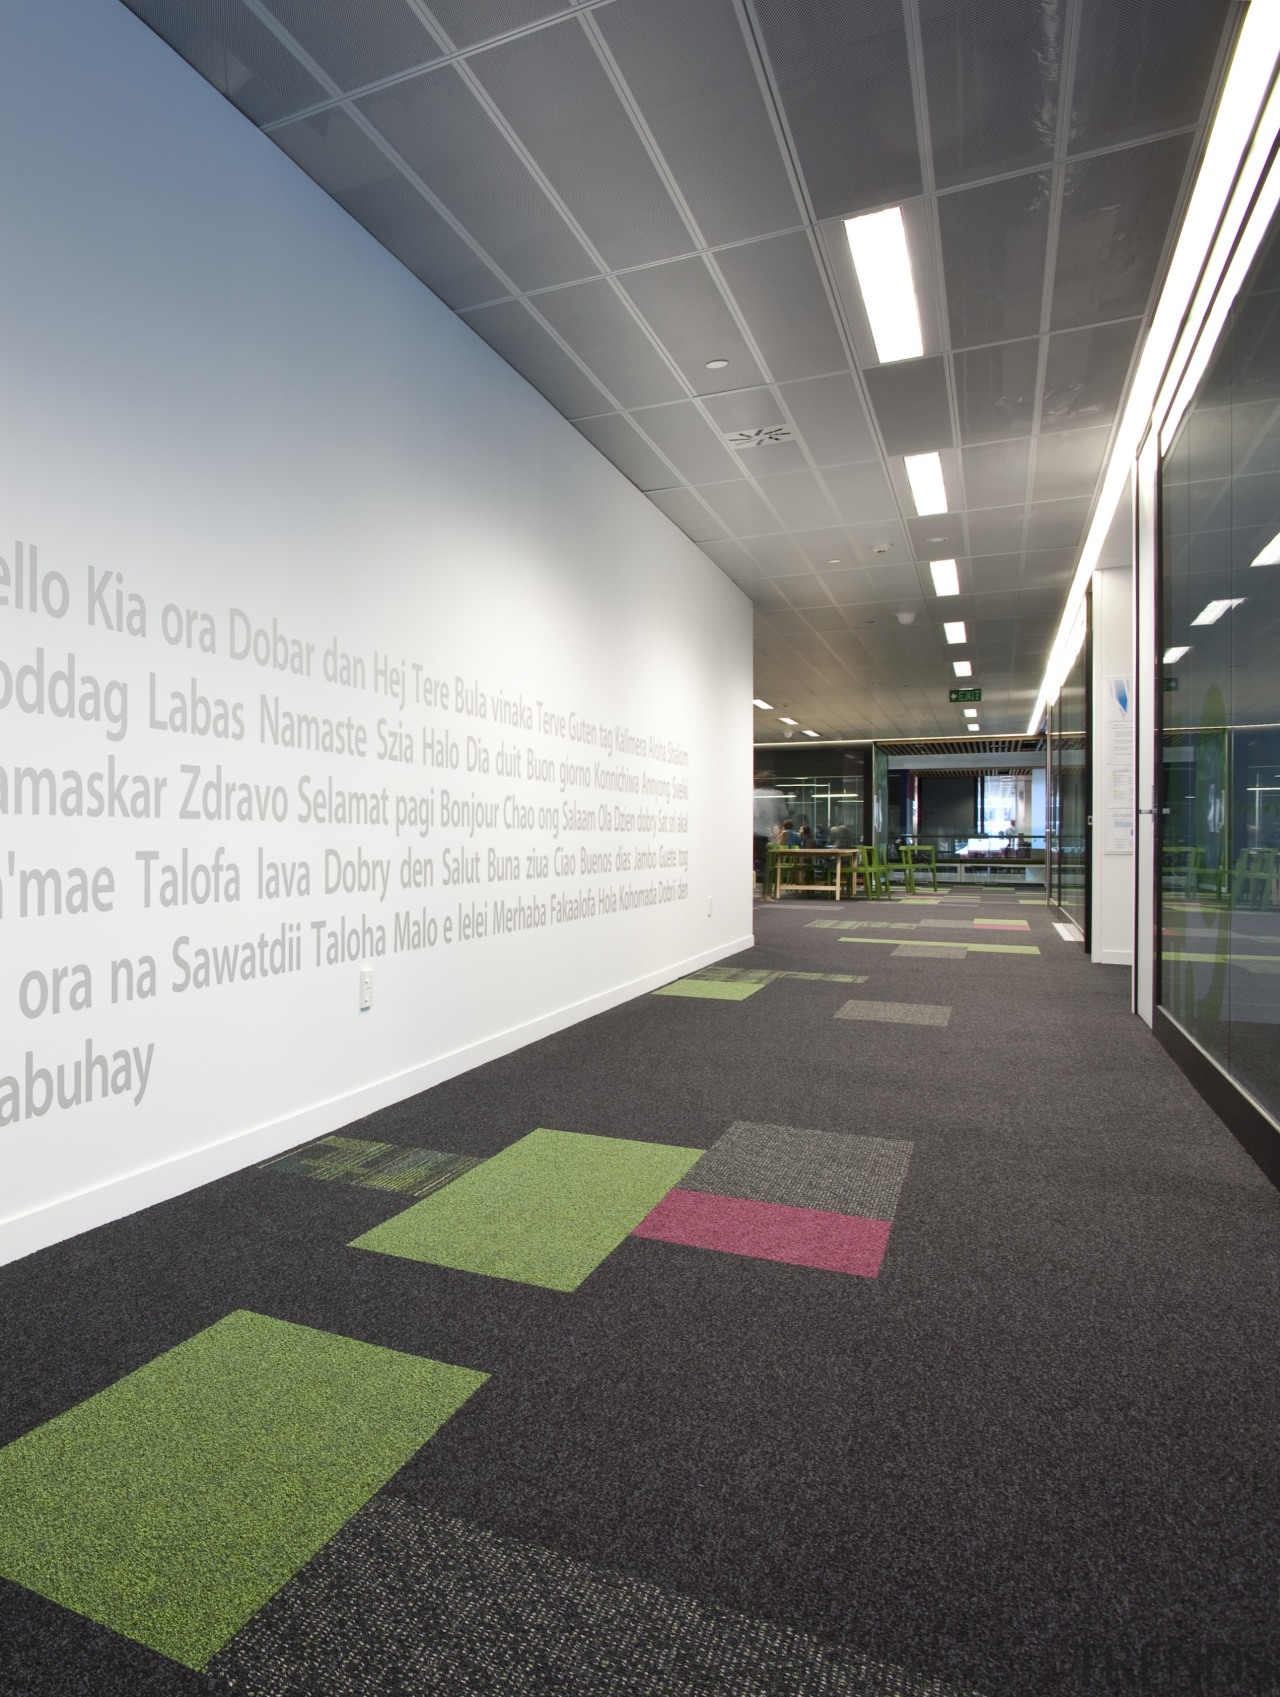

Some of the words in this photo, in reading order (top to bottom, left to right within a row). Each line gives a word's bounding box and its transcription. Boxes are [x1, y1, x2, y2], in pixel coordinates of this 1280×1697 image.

[88, 565, 146, 638] Kia
[162, 603, 216, 654] ora
[230, 608, 315, 677] Dobar
[323, 636, 365, 690] dan
[374, 651, 405, 711] Hej
[412, 663, 449, 710] Tere
[455, 676, 486, 719] Bula
[491, 690, 533, 730] vinaka
[536, 701, 566, 738] Terve
[569, 712, 596, 745] Guten
[599, 724, 612, 757] tag
[958, 690, 981, 701] EXIT
[150, 672, 245, 741] Labas
[260, 694, 367, 757] Namaste
[377, 718, 413, 764] Szia
[423, 726, 459, 770] Halo
[467, 736, 489, 774] Dia
[496, 741, 521, 779] duit
[527, 748, 555, 783] Buon
[560, 756, 591, 793] giorno
[179, 764, 288, 822] Zdravo
[298, 775, 389, 825] Selamat
[396, 788, 434, 838] pagi
[441, 789, 499, 838] Bonjour
[503, 795, 535, 830] Chao
[538, 807, 559, 839] ong
[562, 801, 595, 831] Salaam
[598, 804, 612, 831] Ola
[135, 847, 240, 908] Talofa
[258, 847, 310, 899] lava
[325, 847, 391, 903] Dobry
[400, 846, 433, 889] den
[442, 846, 480, 886] Salut
[488, 848, 520, 882] Buna
[526, 848, 548, 879] ziua
[554, 847, 575, 877] Ciao
[581, 847, 612, 875] Buenos
[634, 845, 656, 870] Jambo
[19, 964, 92, 1019] ora
[111, 956, 156, 1003] na
[172, 922, 301, 992] Sawatdii
[311, 914, 385, 967] Taloha
[394, 907, 437, 953] Malo
[443, 916, 452, 944] e
[459, 901, 487, 941] lelei
[493, 895, 546, 934] Merhaba
[551, 888, 595, 924] Fakaalofa
[599, 886, 616, 915] Hola
